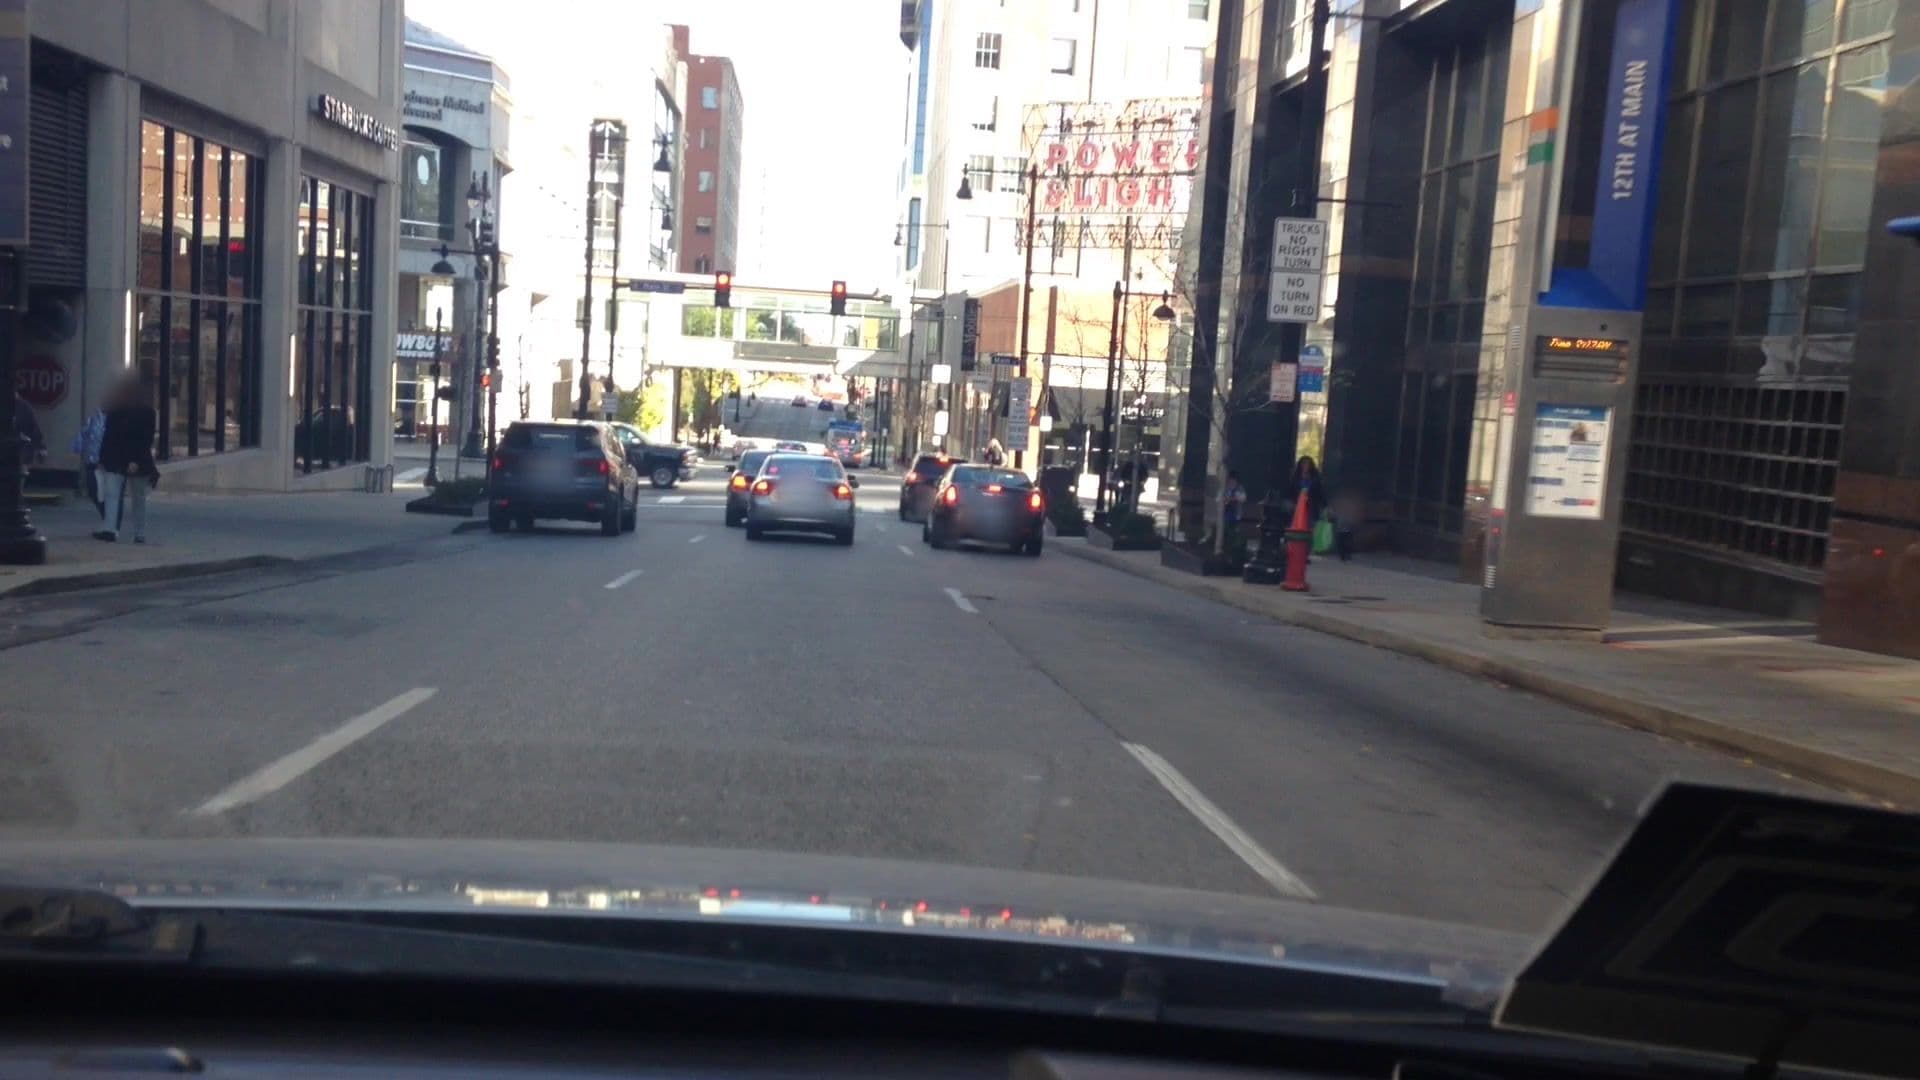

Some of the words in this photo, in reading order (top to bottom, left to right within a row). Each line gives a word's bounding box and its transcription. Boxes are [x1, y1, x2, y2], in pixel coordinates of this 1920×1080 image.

[1620, 60, 1648, 117] MAIN
[324, 95, 373, 139] STARBUCKS
[1617, 121, 1640, 147] AT
[1612, 152, 1636, 200] 12TH
[1282, 223, 1320, 234] TRUCKS
[1290, 235, 1307, 246] NO
[1278, 245, 1318, 256] RIGHT
[1284, 257, 1312, 268] TURN
[1287, 278, 1305, 288] NO
[1282, 291, 1310, 301] TURN
[1273, 304, 1288, 315] ON
[1294, 304, 1314, 316] RED
[15, 368, 65, 392] STOP
